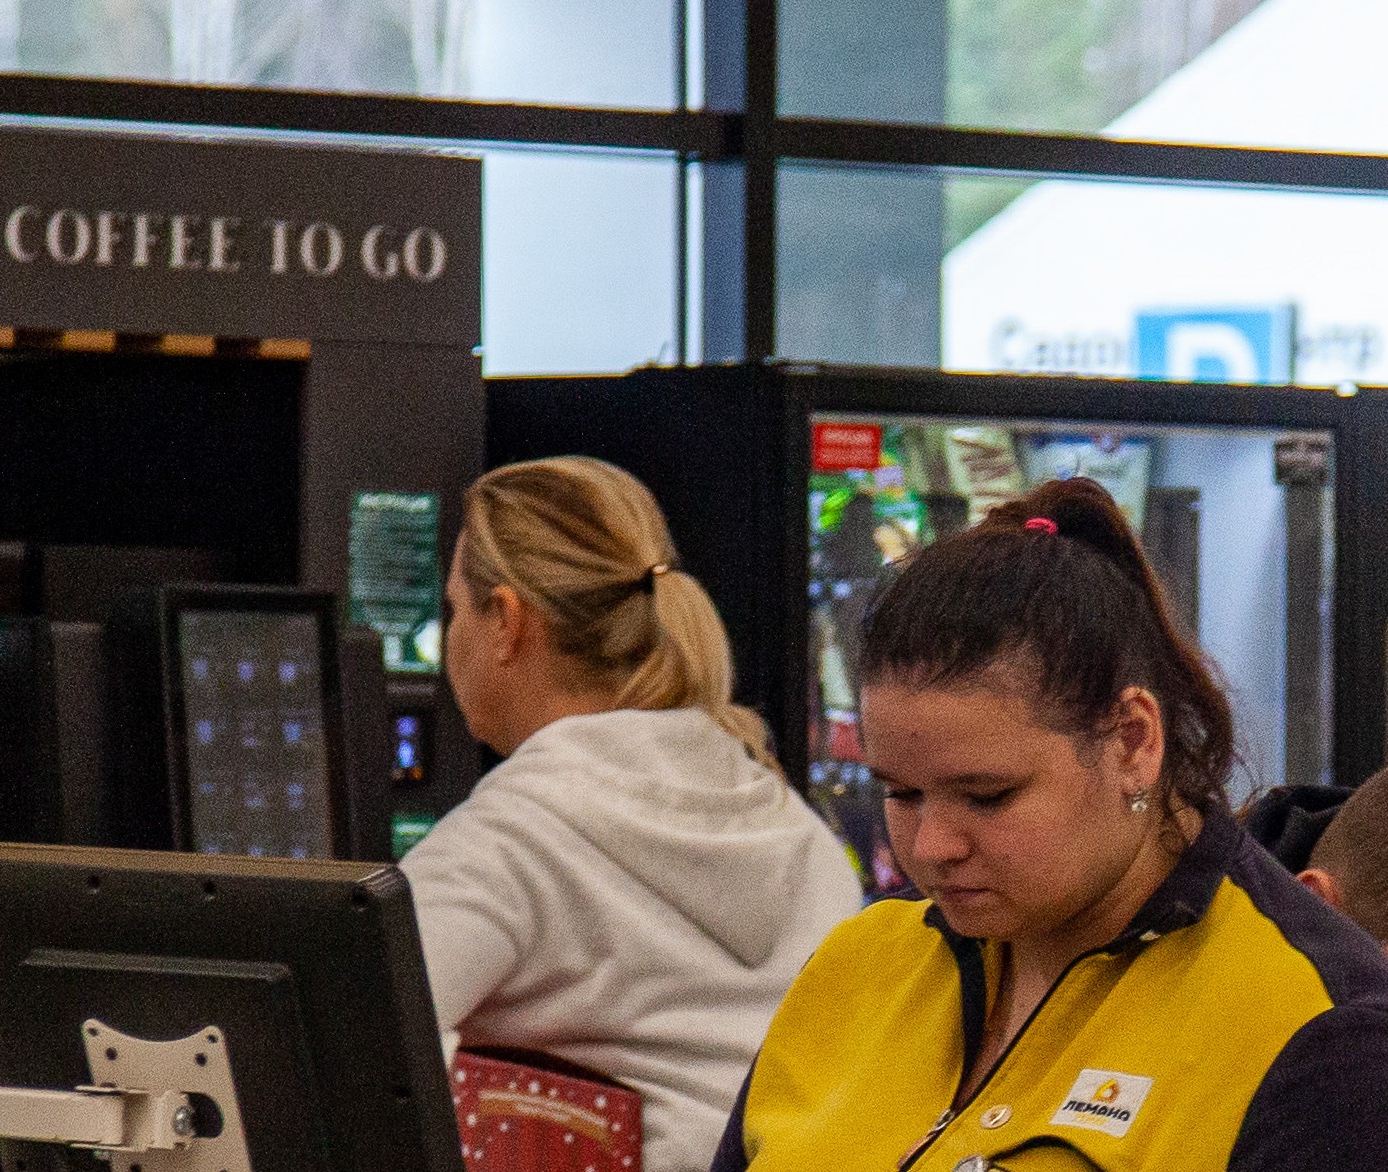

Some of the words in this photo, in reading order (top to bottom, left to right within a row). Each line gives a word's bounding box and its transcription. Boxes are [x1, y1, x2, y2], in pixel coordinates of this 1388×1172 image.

[5, 204, 241, 273] COFFEE
[265, 219, 344, 276] TO
[360, 224, 448, 283] GO
[1062, 1100, 1131, 1122] ЛЕМАНА
